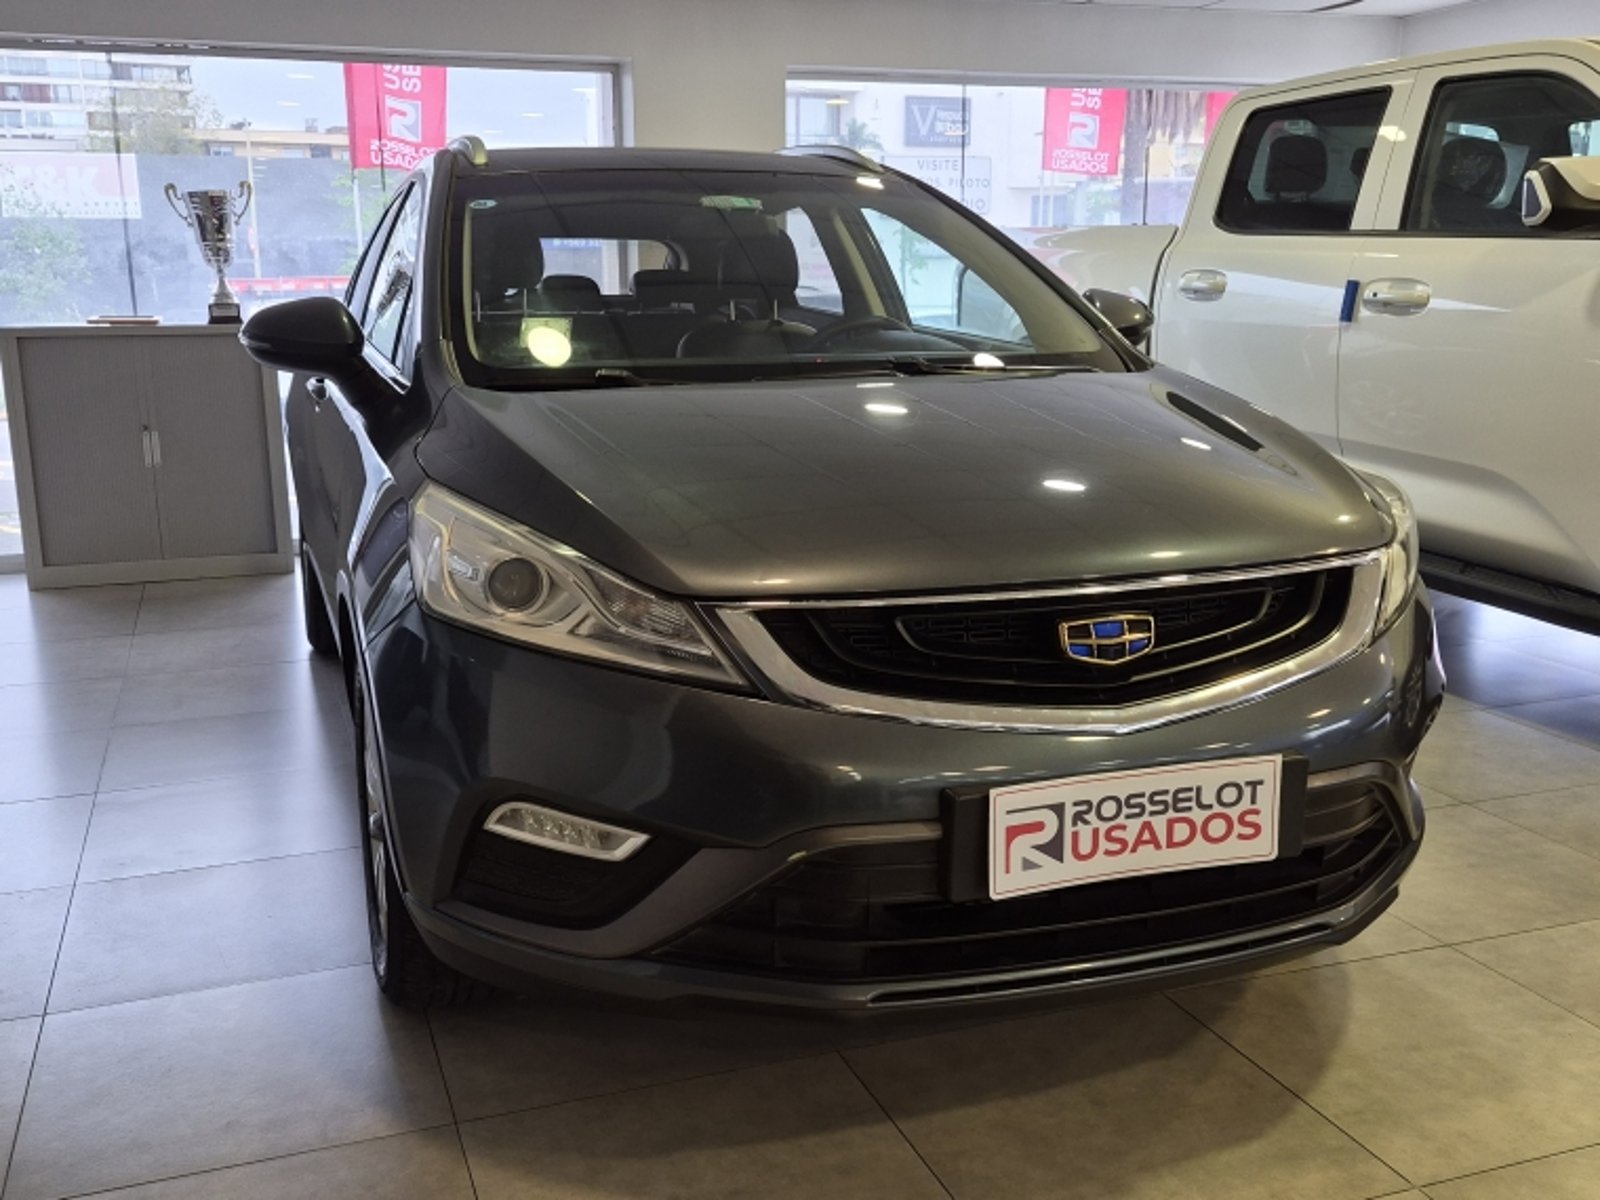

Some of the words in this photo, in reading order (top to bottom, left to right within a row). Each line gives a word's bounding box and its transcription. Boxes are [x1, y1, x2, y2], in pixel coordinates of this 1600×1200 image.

[917, 159, 959, 171] VISITE
[1052, 157, 1108, 173] USADOS
[1072, 778, 1264, 827] ROSSELOT
[1071, 808, 1263, 862] USADOS
